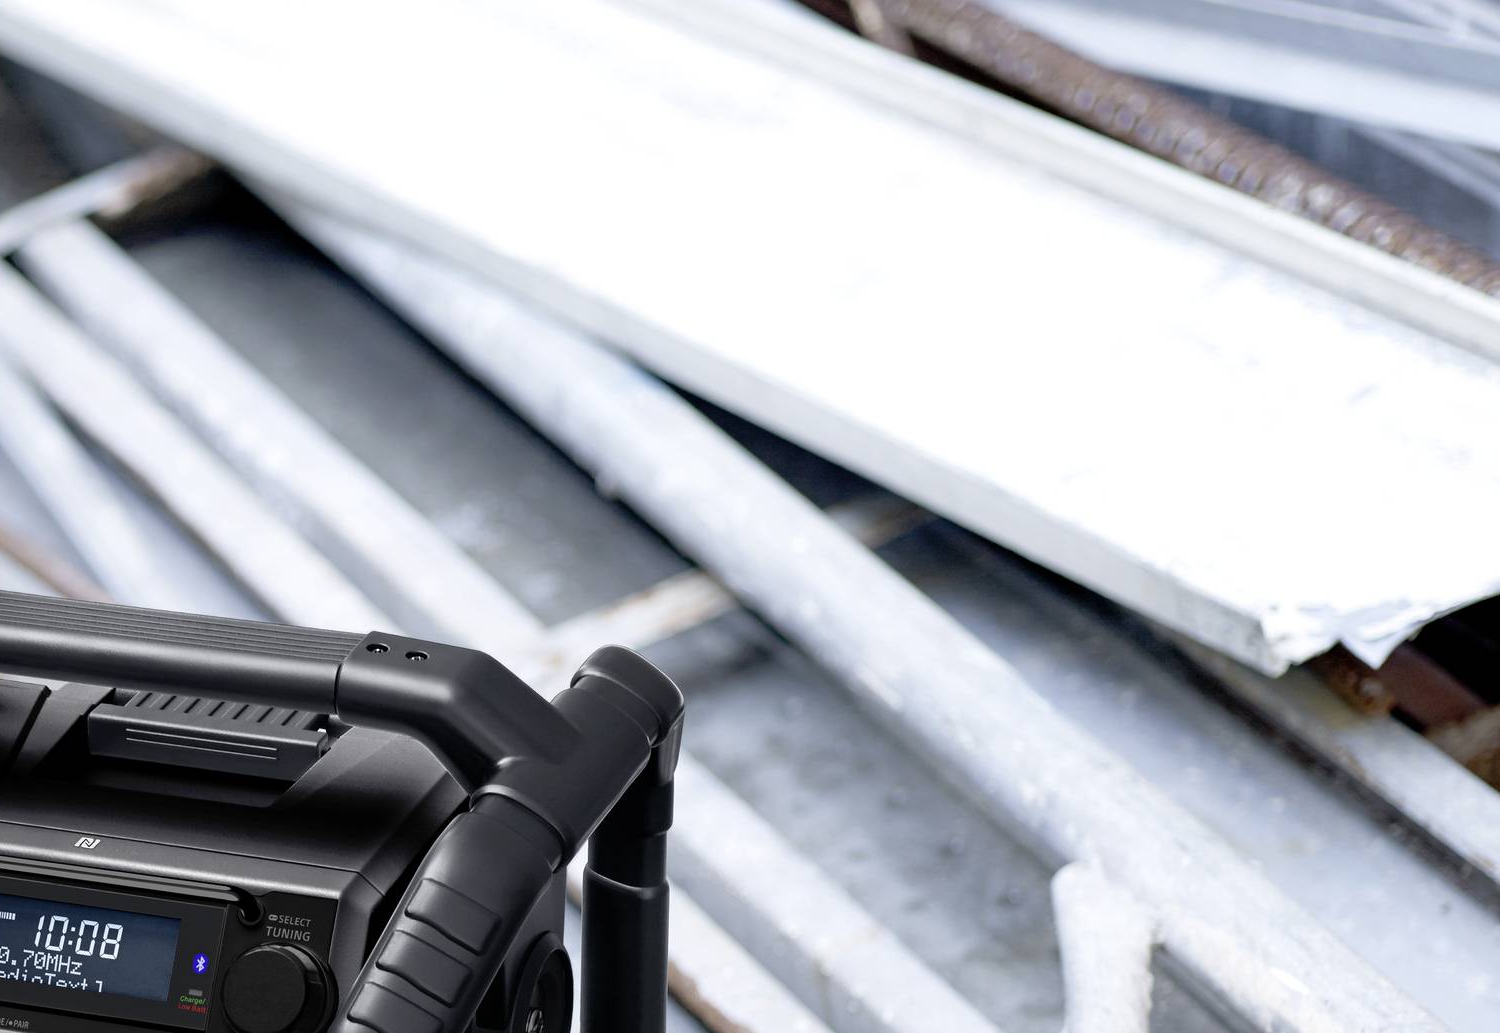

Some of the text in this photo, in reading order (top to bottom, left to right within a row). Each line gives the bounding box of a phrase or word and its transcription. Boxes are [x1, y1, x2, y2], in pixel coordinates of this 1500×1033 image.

[279, 915, 311, 927] SELECT
[34, 915, 124, 960] 10:08
[266, 926, 311, 942] TUNING
